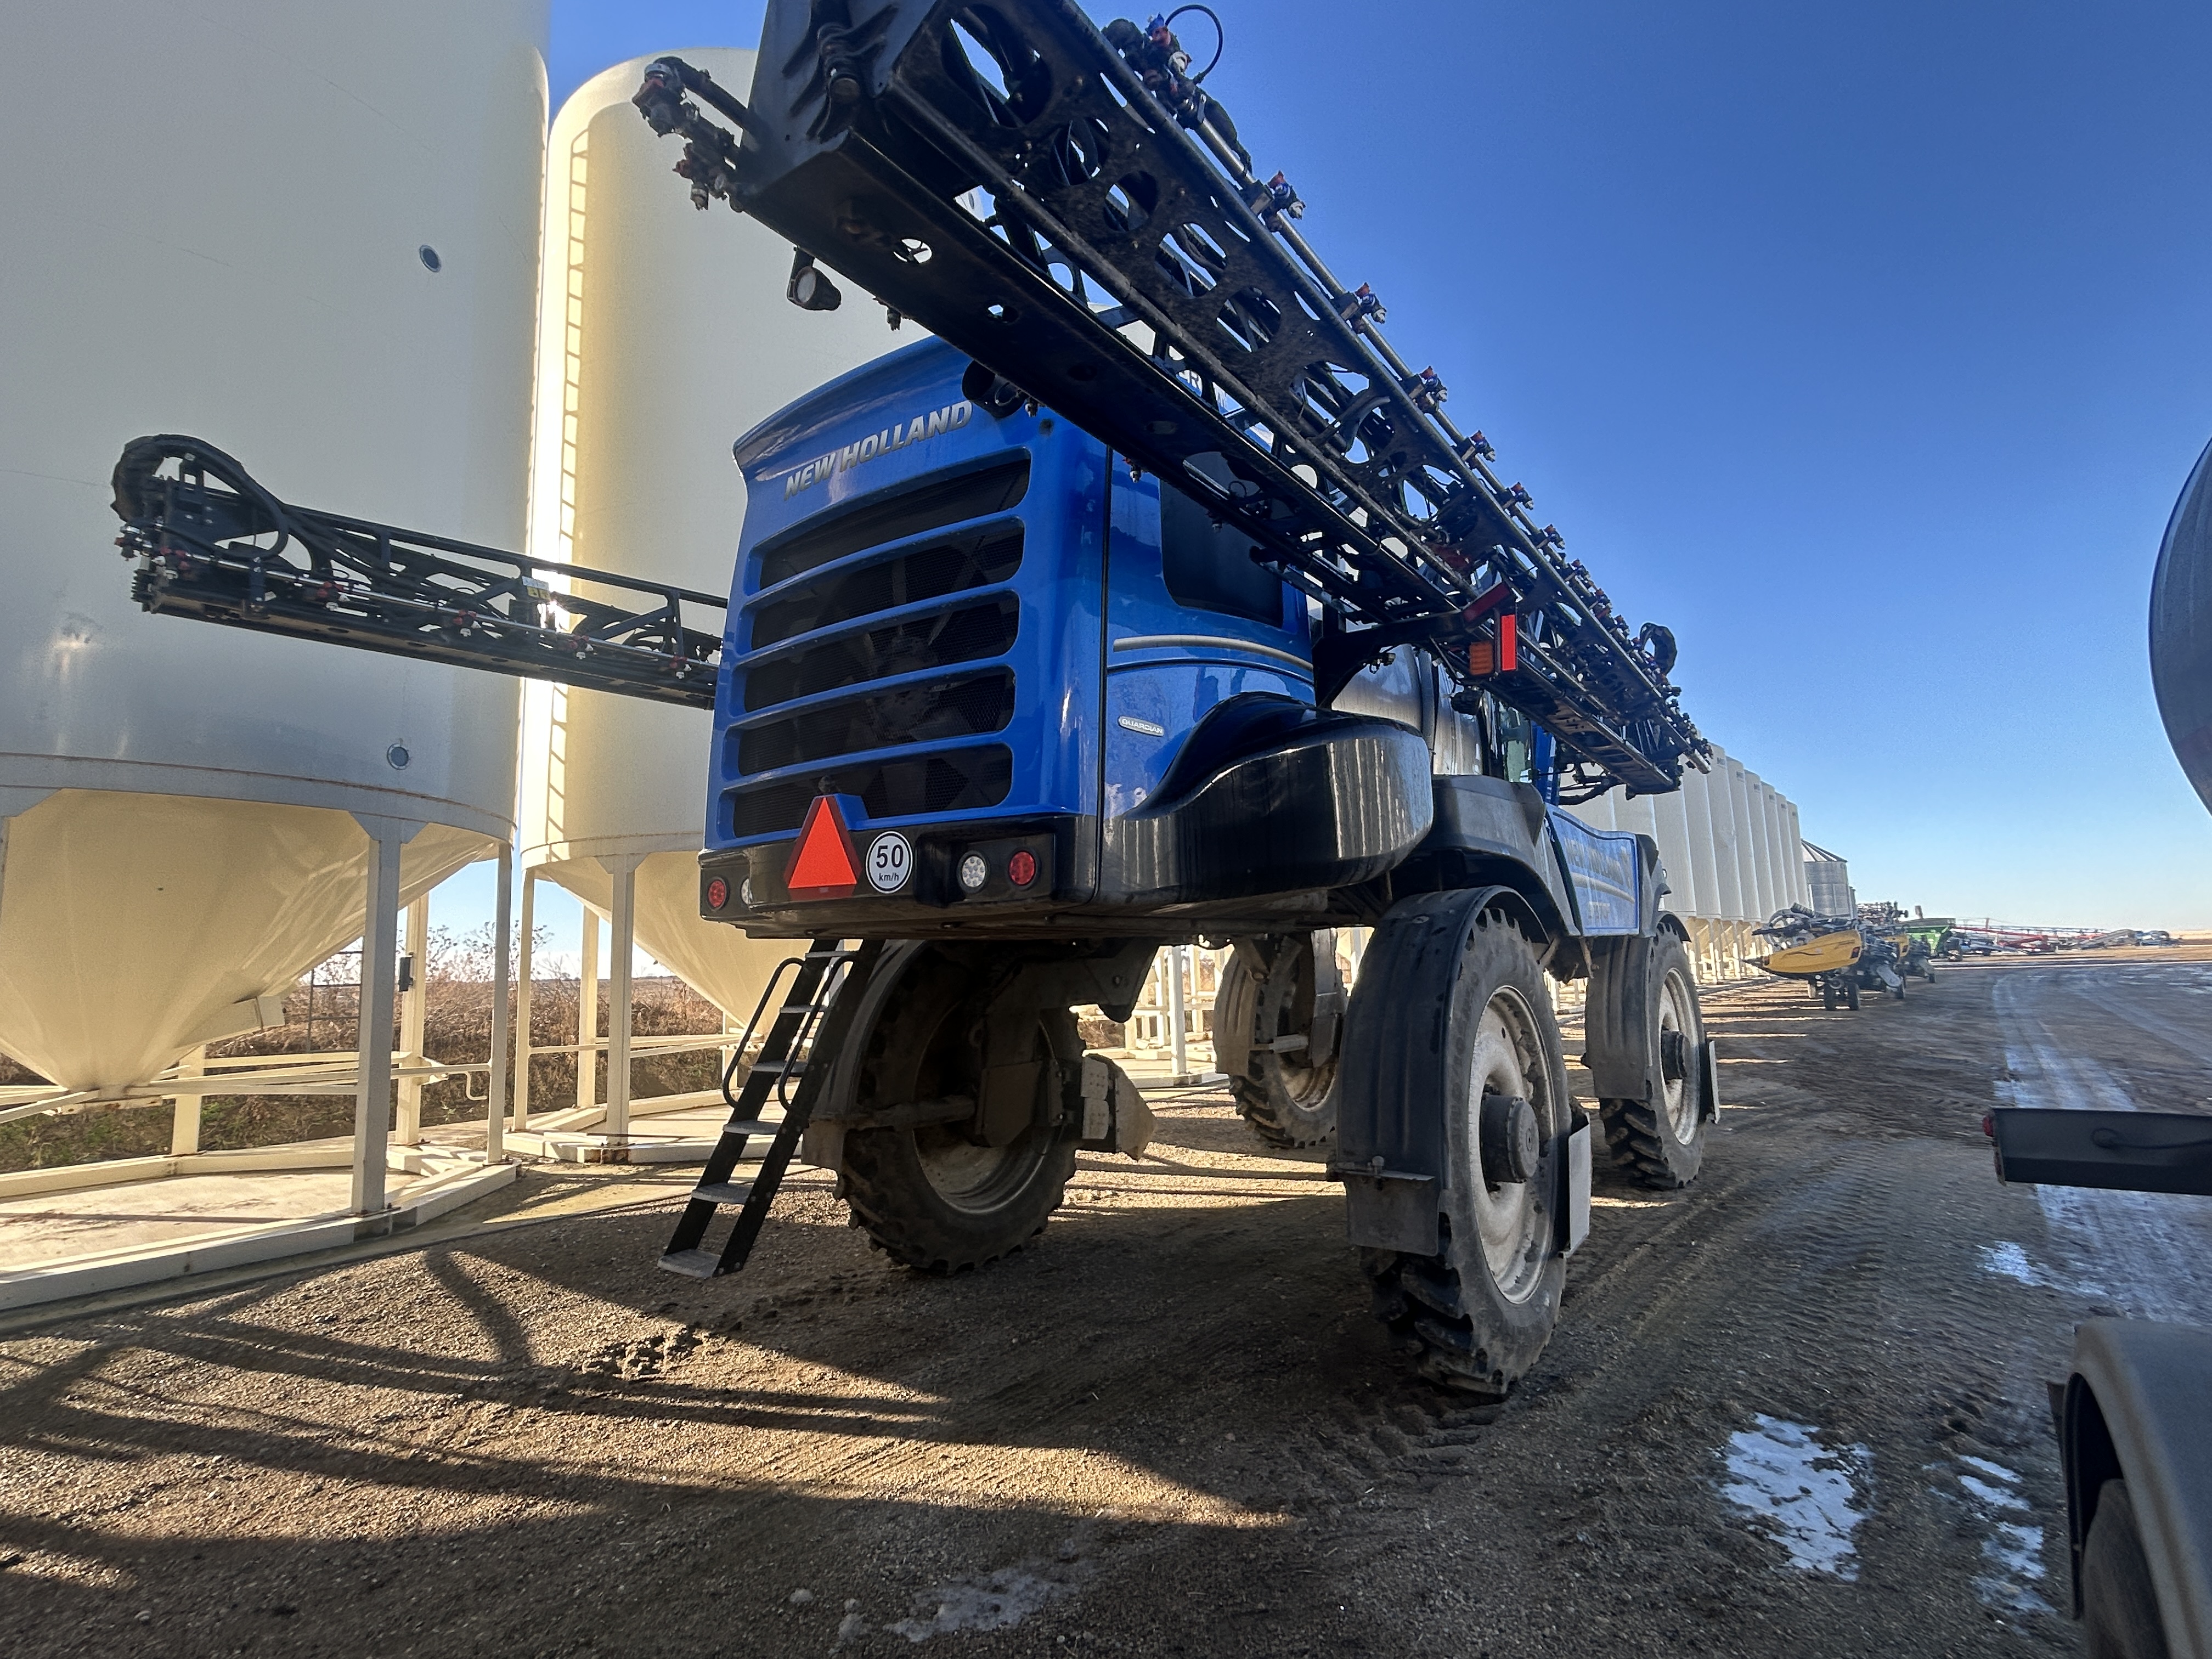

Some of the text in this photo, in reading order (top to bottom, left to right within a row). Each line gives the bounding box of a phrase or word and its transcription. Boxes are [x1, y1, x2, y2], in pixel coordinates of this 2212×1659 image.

[784, 400, 973, 501] NEW HOLLAND
[1122, 719, 1163, 733] GUARDIAN
[876, 844, 904, 868] 50
[879, 872, 899, 881] km/h
